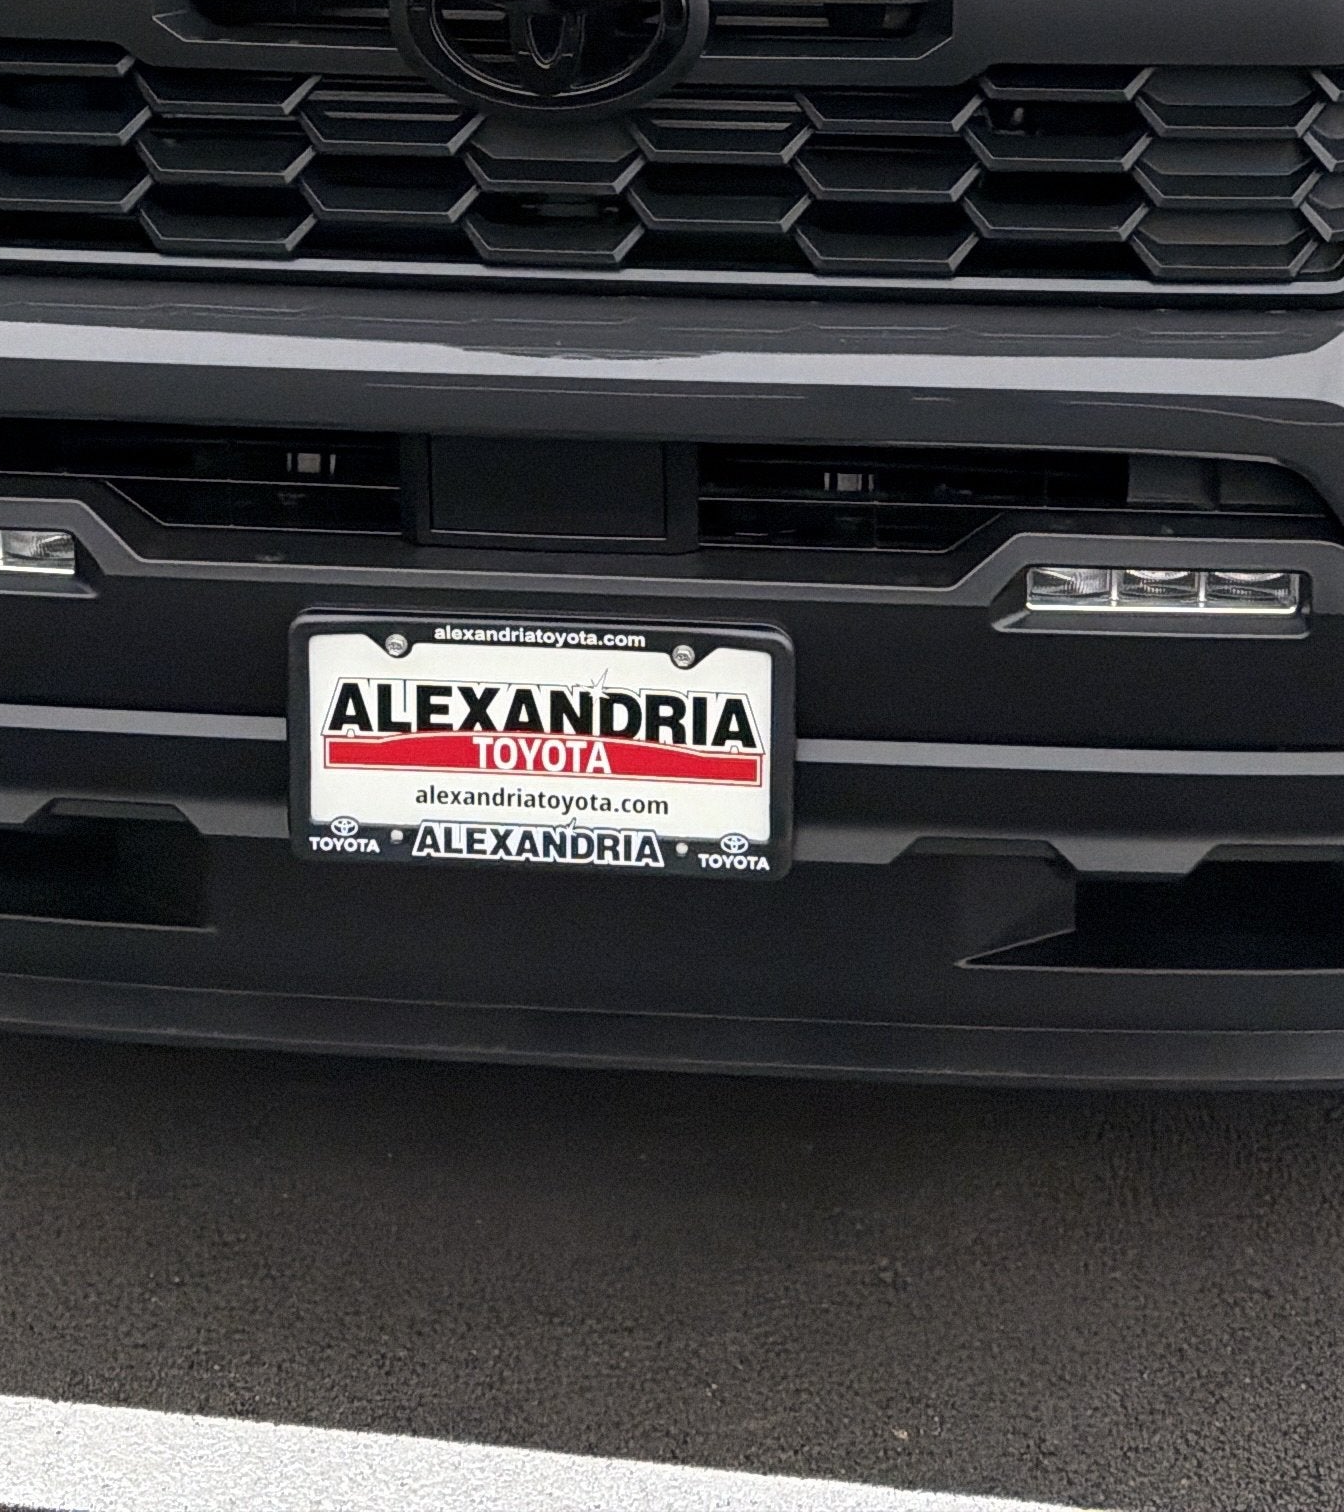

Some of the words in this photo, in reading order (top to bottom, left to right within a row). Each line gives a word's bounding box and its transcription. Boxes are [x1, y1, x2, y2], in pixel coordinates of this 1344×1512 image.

[434, 625, 646, 648] alexandriatoyota.com
[328, 682, 757, 748] ALEXANDRIA
[472, 737, 612, 774] TOYOTA
[415, 785, 669, 815] alexandriatoyota.com
[309, 836, 380, 853] TOYOTA
[413, 822, 664, 867] ALEXANDRIA
[698, 854, 770, 870] TOYOTA
